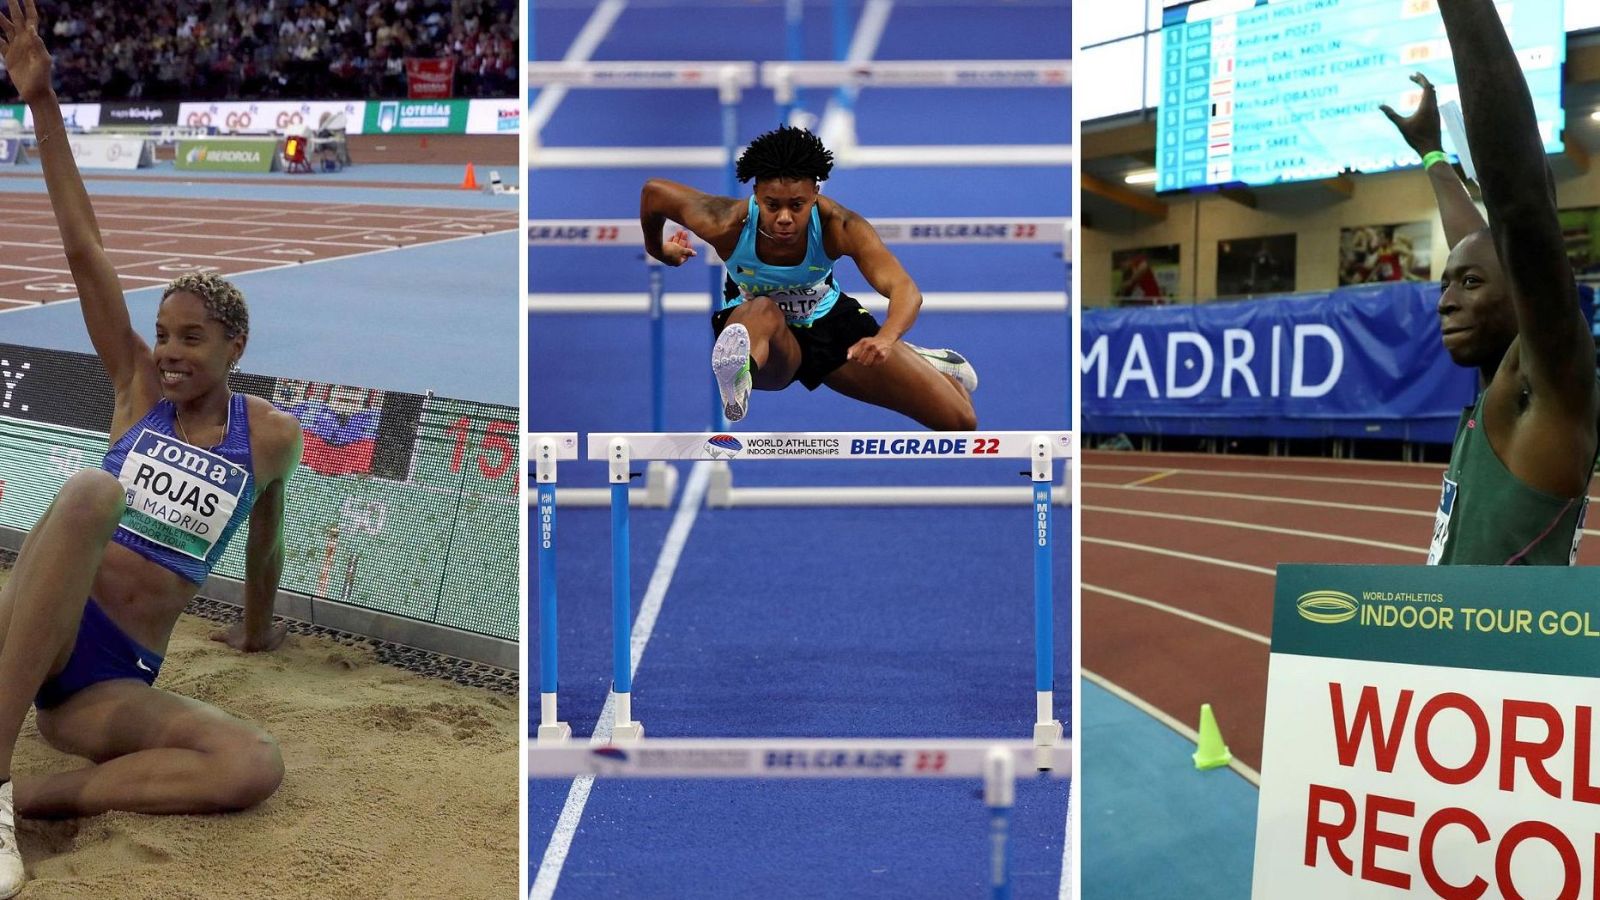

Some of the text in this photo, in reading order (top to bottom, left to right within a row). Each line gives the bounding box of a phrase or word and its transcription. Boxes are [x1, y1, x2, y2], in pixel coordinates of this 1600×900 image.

[1237, 33, 1281, 48] Andrew
[1271, 49, 1294, 62] DAL
[1299, 40, 1342, 55] MOLIN
[1267, 64, 1327, 83] MARTINEZ
[1330, 54, 1386, 74] ECHARTE
[400, 103, 451, 117] LOTERÍAS
[1235, 96, 1280, 110] Michael
[1234, 119, 1273, 133] Enrique
[206, 150, 261, 163] IBERDROLA
[1265, 156, 1307, 172] LAKKA
[597, 226, 619, 241] 22
[910, 224, 1008, 238] BELGRADE
[1014, 224, 1036, 238] 22
[747, 439, 839, 447] WORLD ATHLETICS
[850, 438, 1000, 455] BELGRADE 22
[133, 463, 219, 518] ROJAS
[143, 498, 210, 535] MADRID
[149, 518, 197, 544] ATHLETICS
[541, 505, 553, 549] MONDO
[1036, 503, 1048, 547] MONDO
[163, 534, 188, 550] TOUR
[1363, 591, 1444, 603] WORLD ATHLETICS
[1360, 604, 1454, 630] INDOOR
[1460, 607, 1532, 633] TOUR
[1304, 783, 1600, 900] RECO
